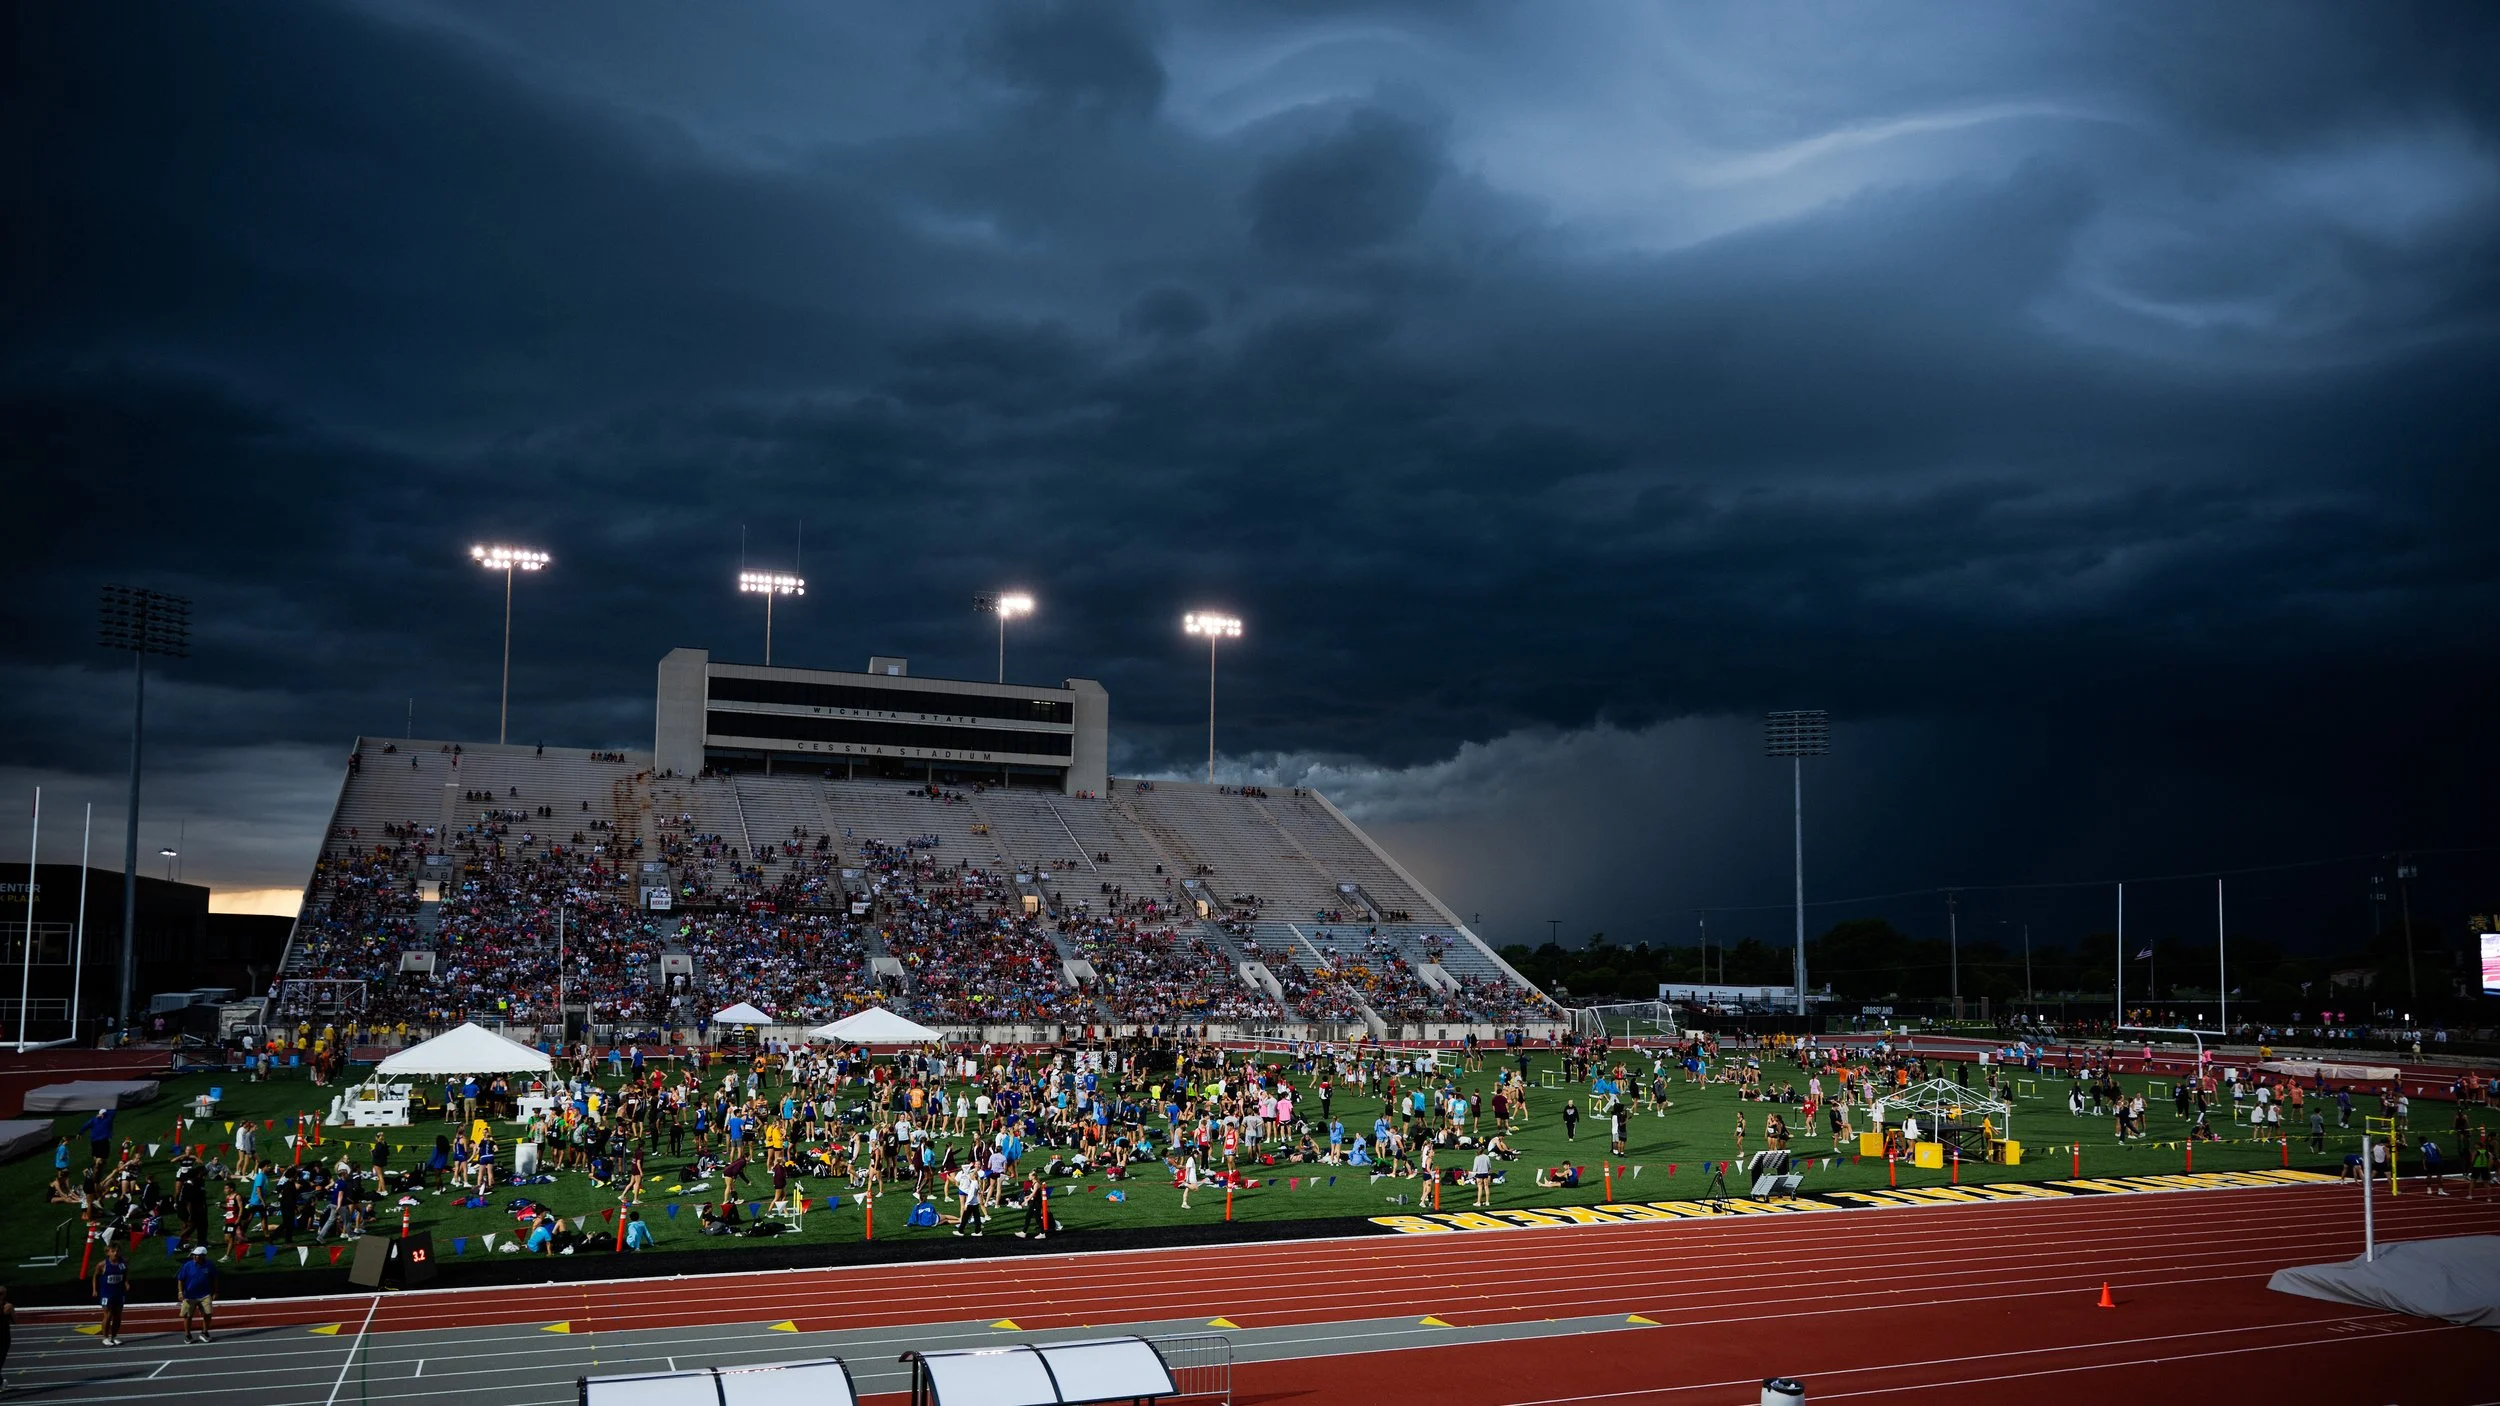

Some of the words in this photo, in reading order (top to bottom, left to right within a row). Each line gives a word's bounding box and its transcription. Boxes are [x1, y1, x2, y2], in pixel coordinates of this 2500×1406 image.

[813, 707, 897, 719] WICHITA
[920, 714, 977, 724] STATE
[797, 742, 883, 755] CESSNA
[900, 748, 991, 761] STADIUM
[8, 895, 40, 903] PLAA
[2042, 1169, 2354, 1194] WICHITA
[1821, 1183, 2074, 1207] STATE
[1367, 1195, 1843, 1234] SHOCKERS
